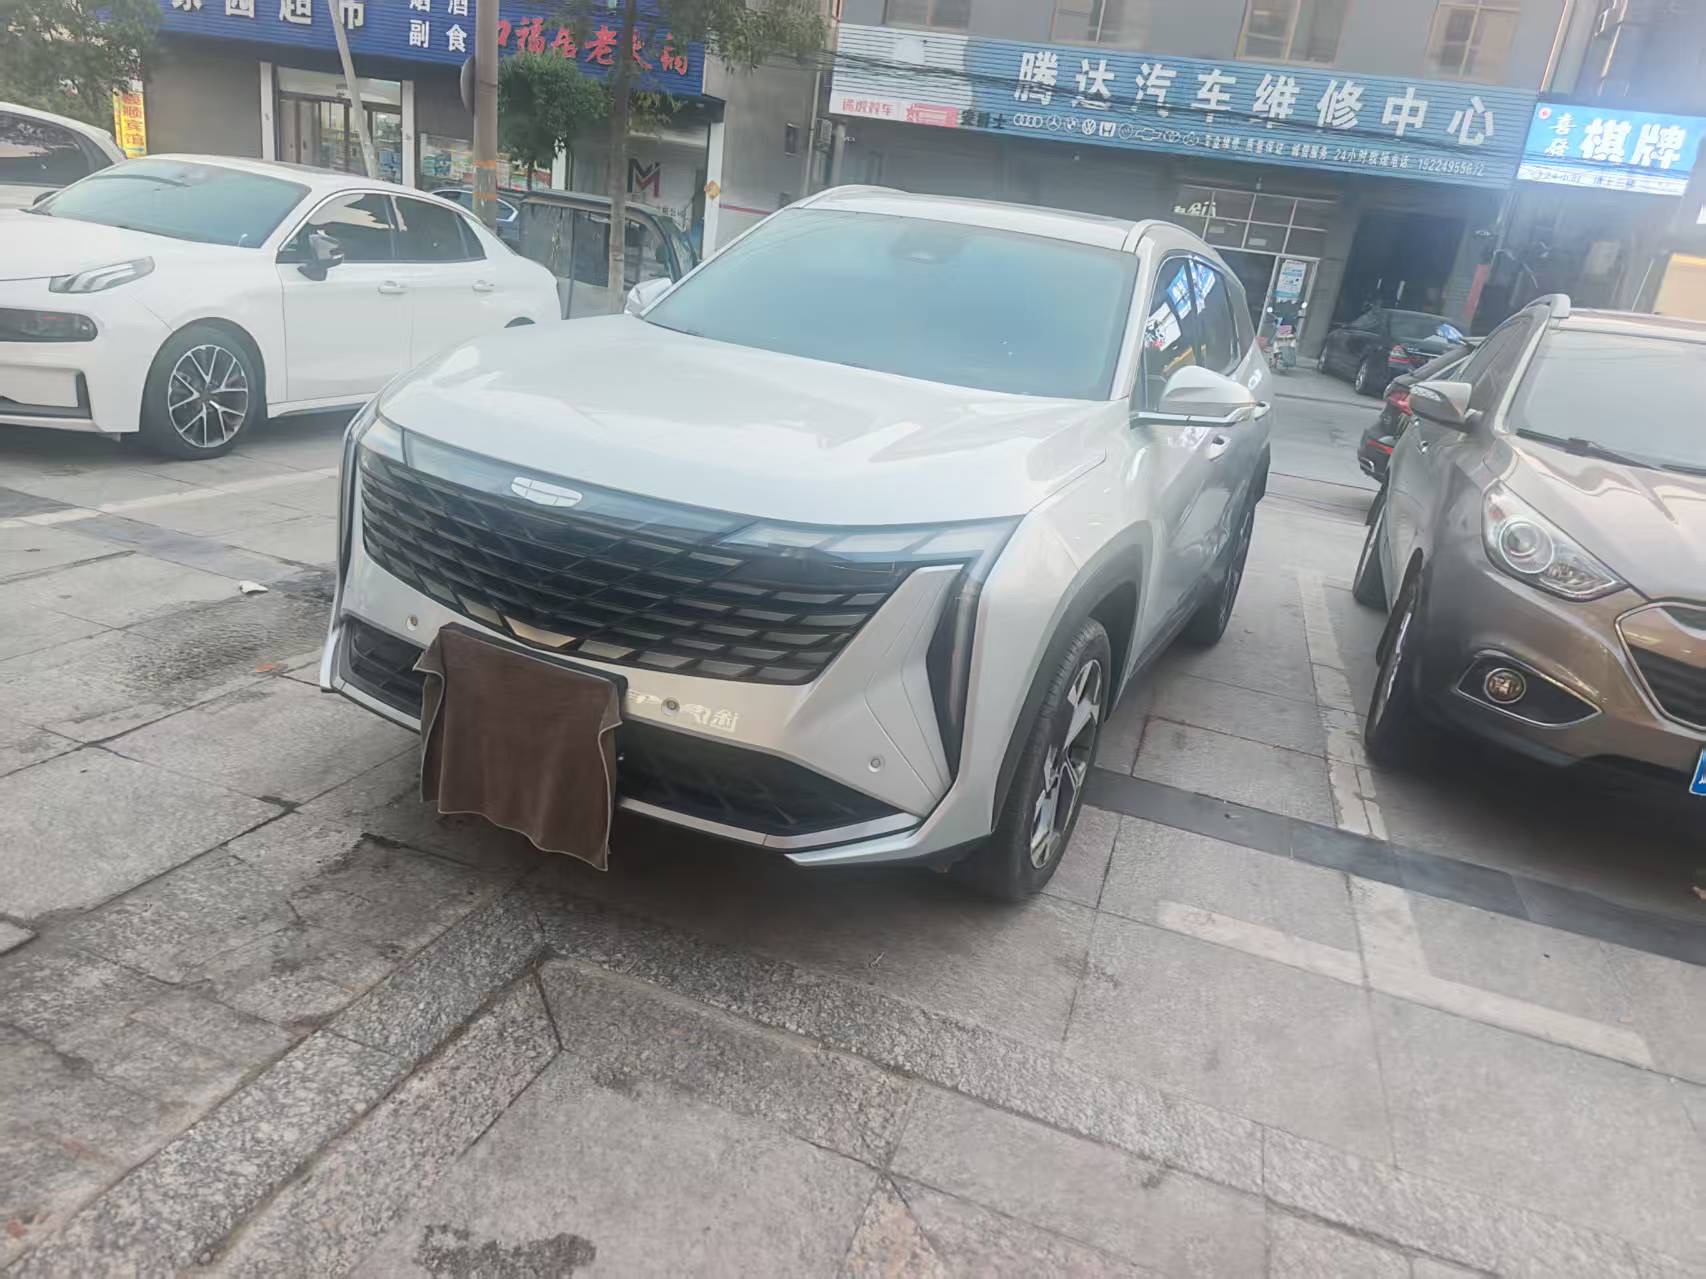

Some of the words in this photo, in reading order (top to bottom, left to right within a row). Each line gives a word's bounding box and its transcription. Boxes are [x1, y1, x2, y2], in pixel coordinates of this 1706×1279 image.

[409, 20, 468, 53] 副食
[1013, 50, 1496, 147] 腾达汽车维修中心
[1579, 117, 1687, 170] 棋牌
